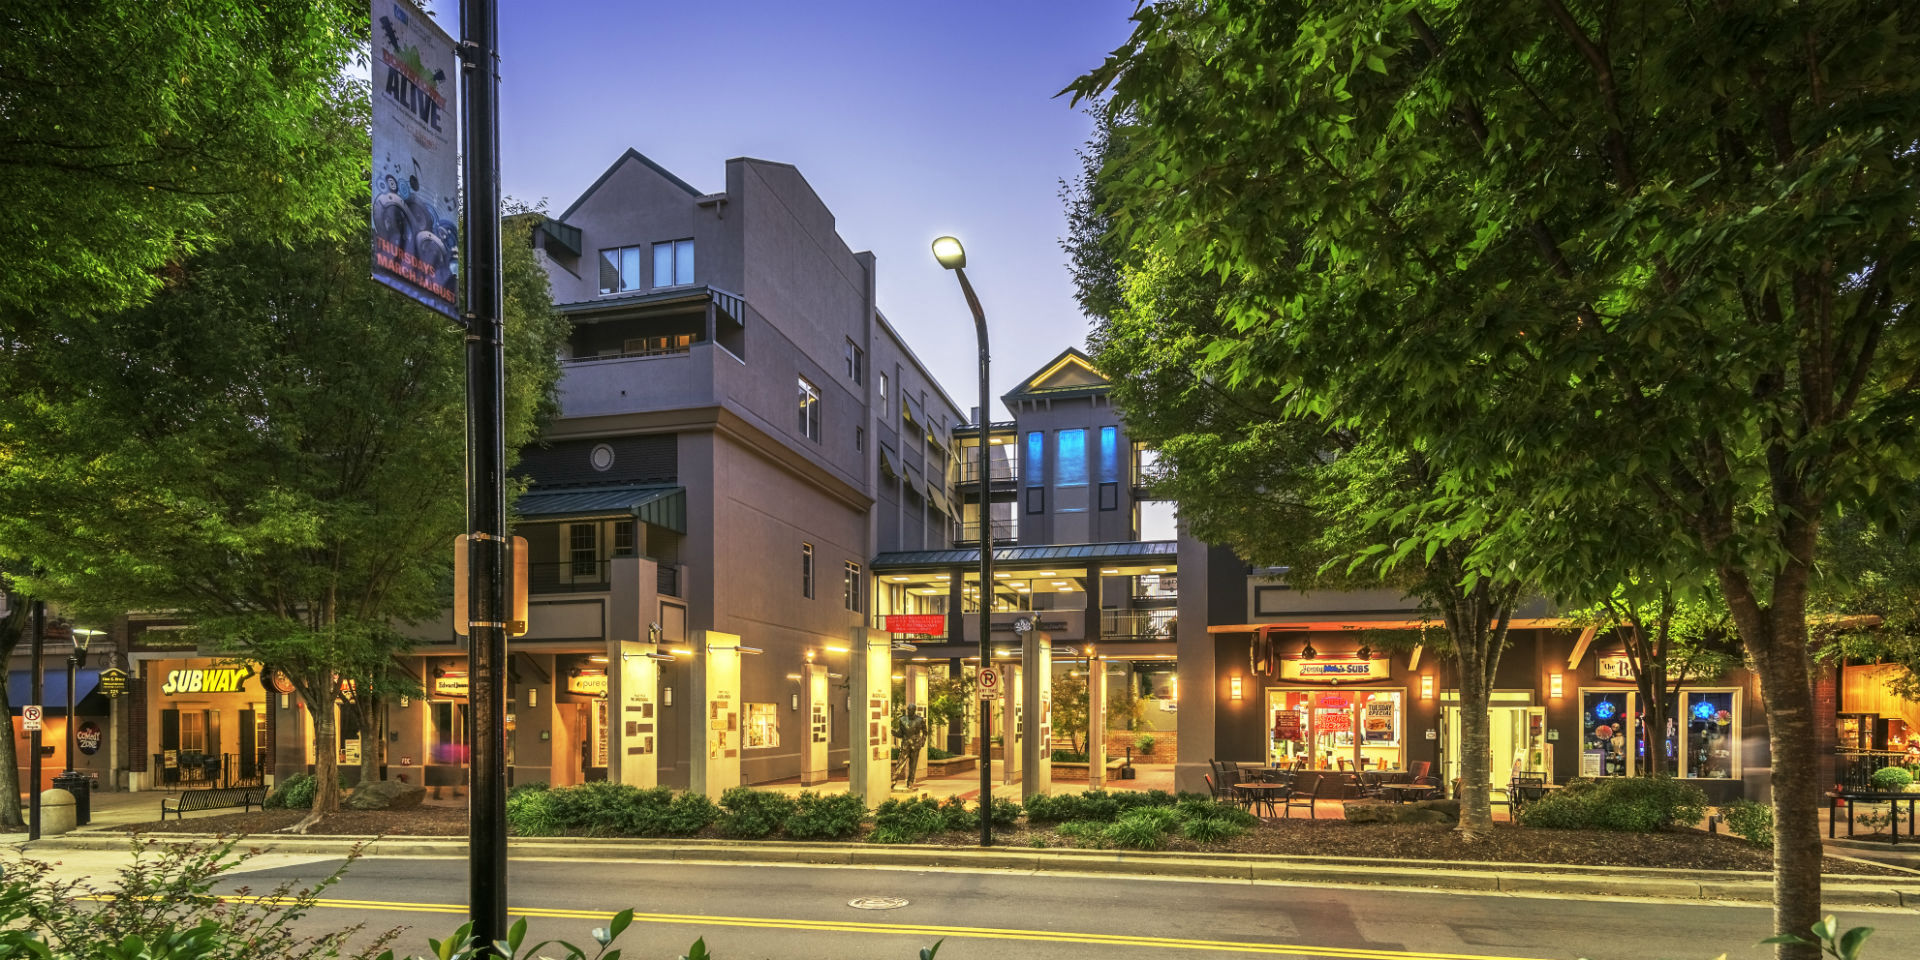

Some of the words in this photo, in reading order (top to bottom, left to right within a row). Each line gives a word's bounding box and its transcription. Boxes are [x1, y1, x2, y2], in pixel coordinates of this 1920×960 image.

[386, 67, 442, 133] ALIVE
[377, 236, 436, 278] THURSDAYS
[1346, 664, 1370, 673] SUBS
[163, 666, 249, 694] SUBWAY
[583, 680, 600, 688] pure
[80, 740, 98, 748] ZONE
